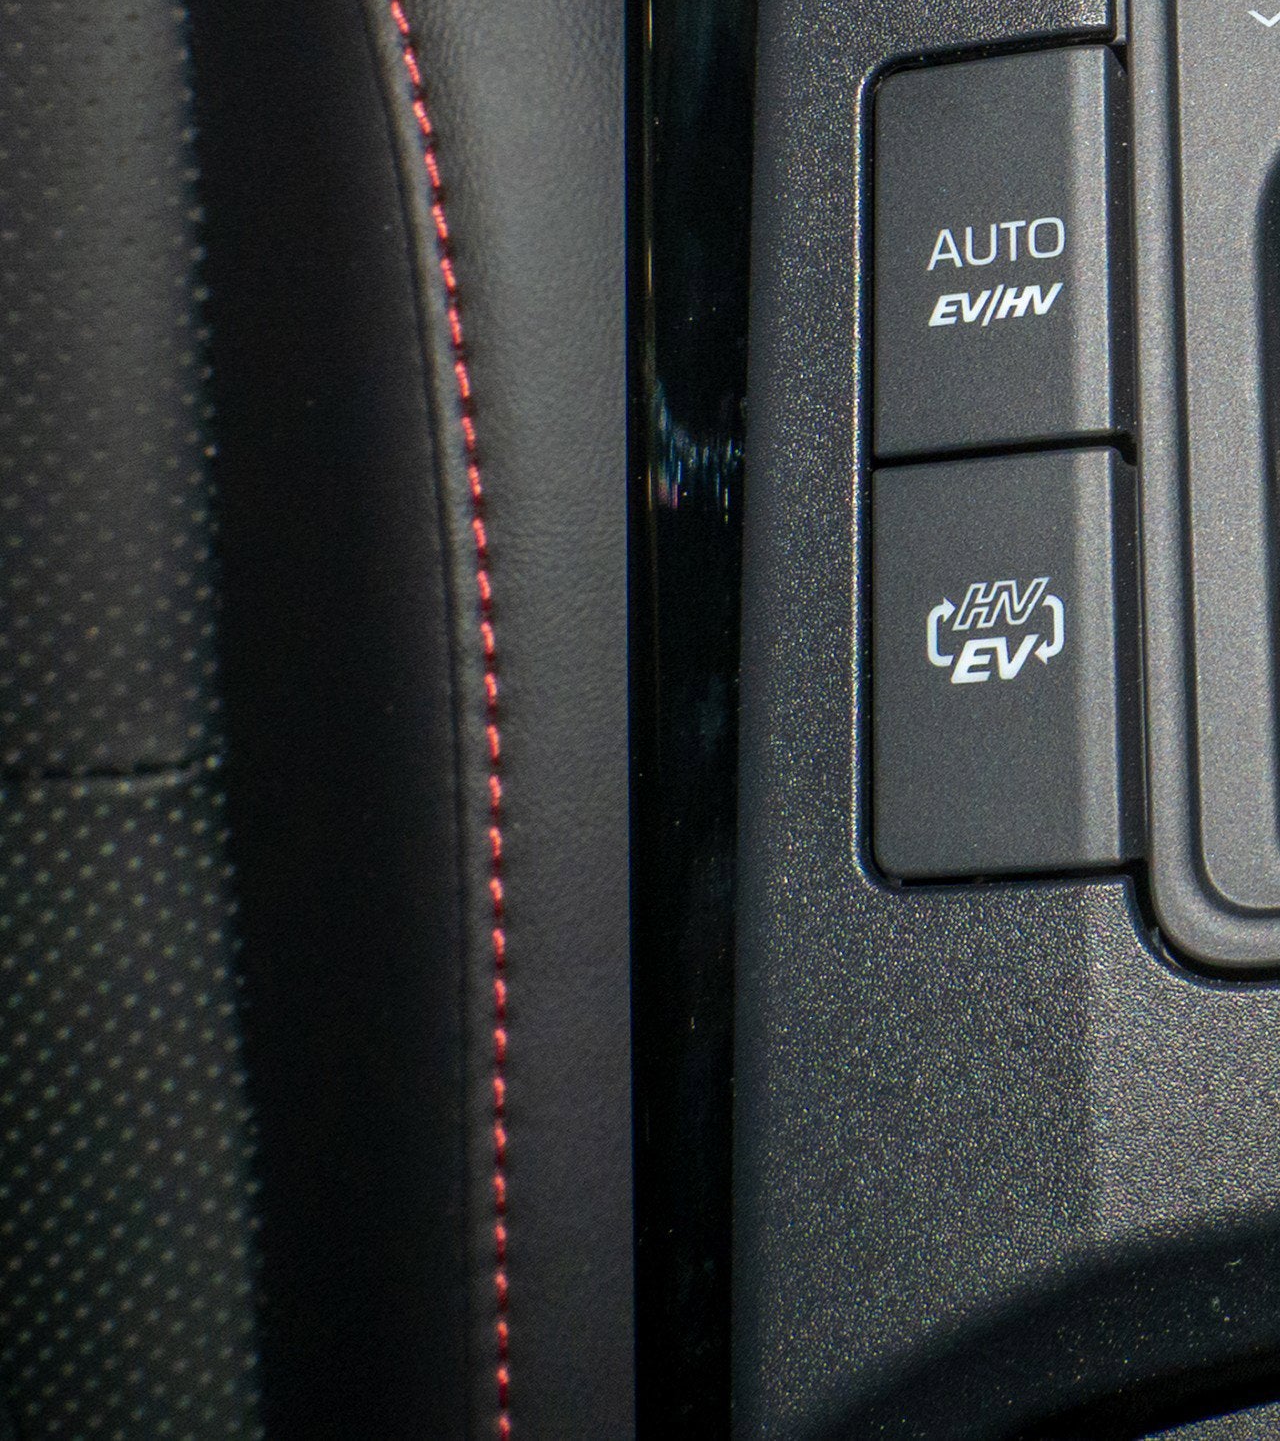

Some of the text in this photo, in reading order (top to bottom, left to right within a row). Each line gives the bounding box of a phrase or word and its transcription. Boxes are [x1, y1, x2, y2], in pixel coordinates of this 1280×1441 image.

[926, 216, 1066, 271] AUTO
[928, 282, 1063, 327] EV/HV
[952, 576, 1050, 631] HV
[950, 633, 1040, 684] EV
